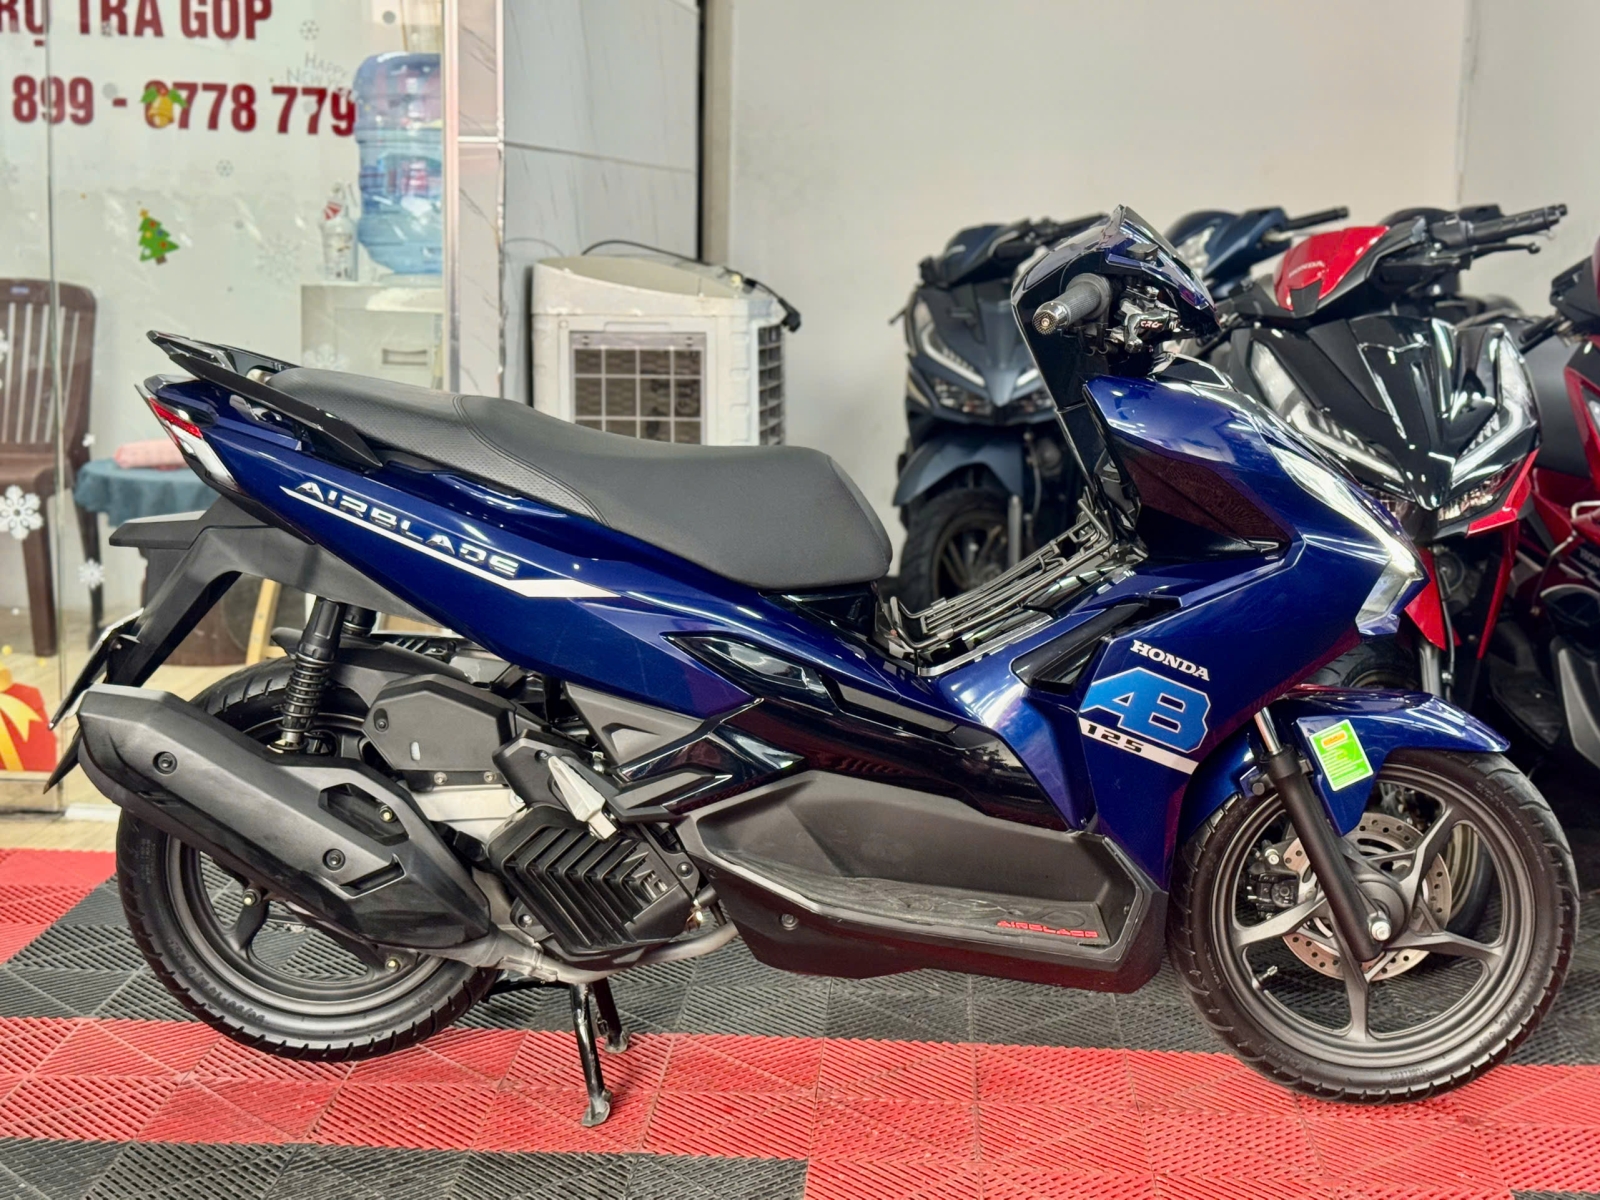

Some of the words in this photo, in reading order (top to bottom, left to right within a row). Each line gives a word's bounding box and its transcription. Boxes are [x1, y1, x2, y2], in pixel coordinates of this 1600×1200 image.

[12, 75, 94, 126] 899
[271, 86, 356, 137] 779
[294, 480, 520, 578] AIRBLADE
[1130, 639, 1210, 682] HONDA
[1087, 722, 1145, 754] 125
